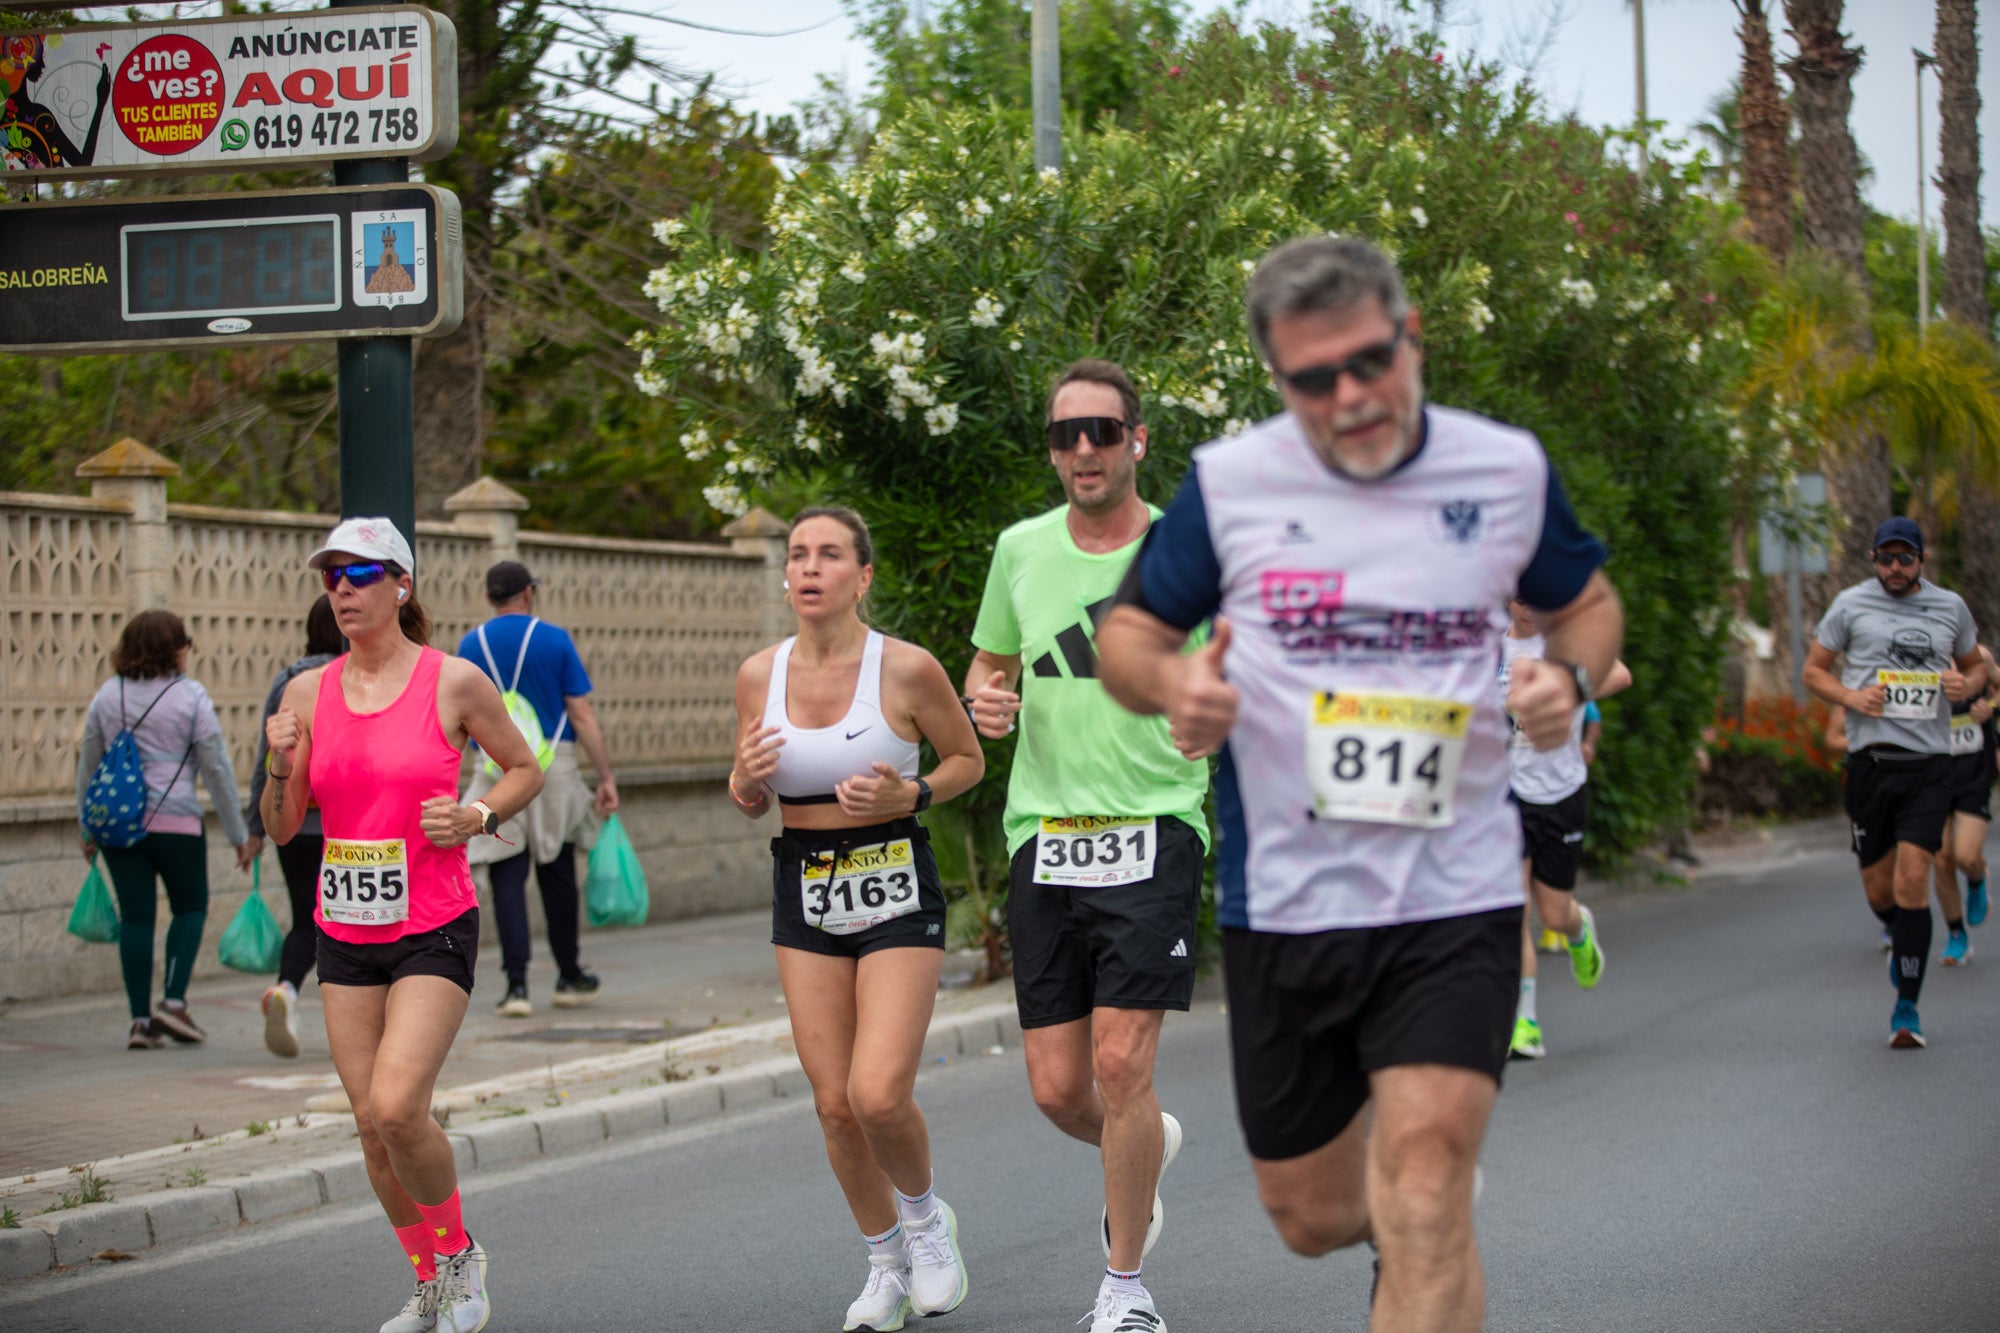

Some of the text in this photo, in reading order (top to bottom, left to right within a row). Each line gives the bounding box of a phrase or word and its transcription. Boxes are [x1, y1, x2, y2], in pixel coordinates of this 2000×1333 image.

[228, 26, 418, 59] ANÚNCIATE
[127, 49, 191, 82] ¿me
[232, 51, 412, 108] AQUÍ
[148, 69, 219, 99] ves?
[121, 102, 218, 123] TUS CLIENTES
[254, 107, 418, 149] 619 472 758
[136, 120, 203, 143] TAMBIÉN
[0, 262, 109, 289] SALOBREÑA
[1884, 686, 1938, 708] 3027
[1333, 736, 1441, 791] 814
[1041, 830, 1146, 868] 3031
[323, 868, 405, 903] 3155
[807, 872, 913, 916] 3163
